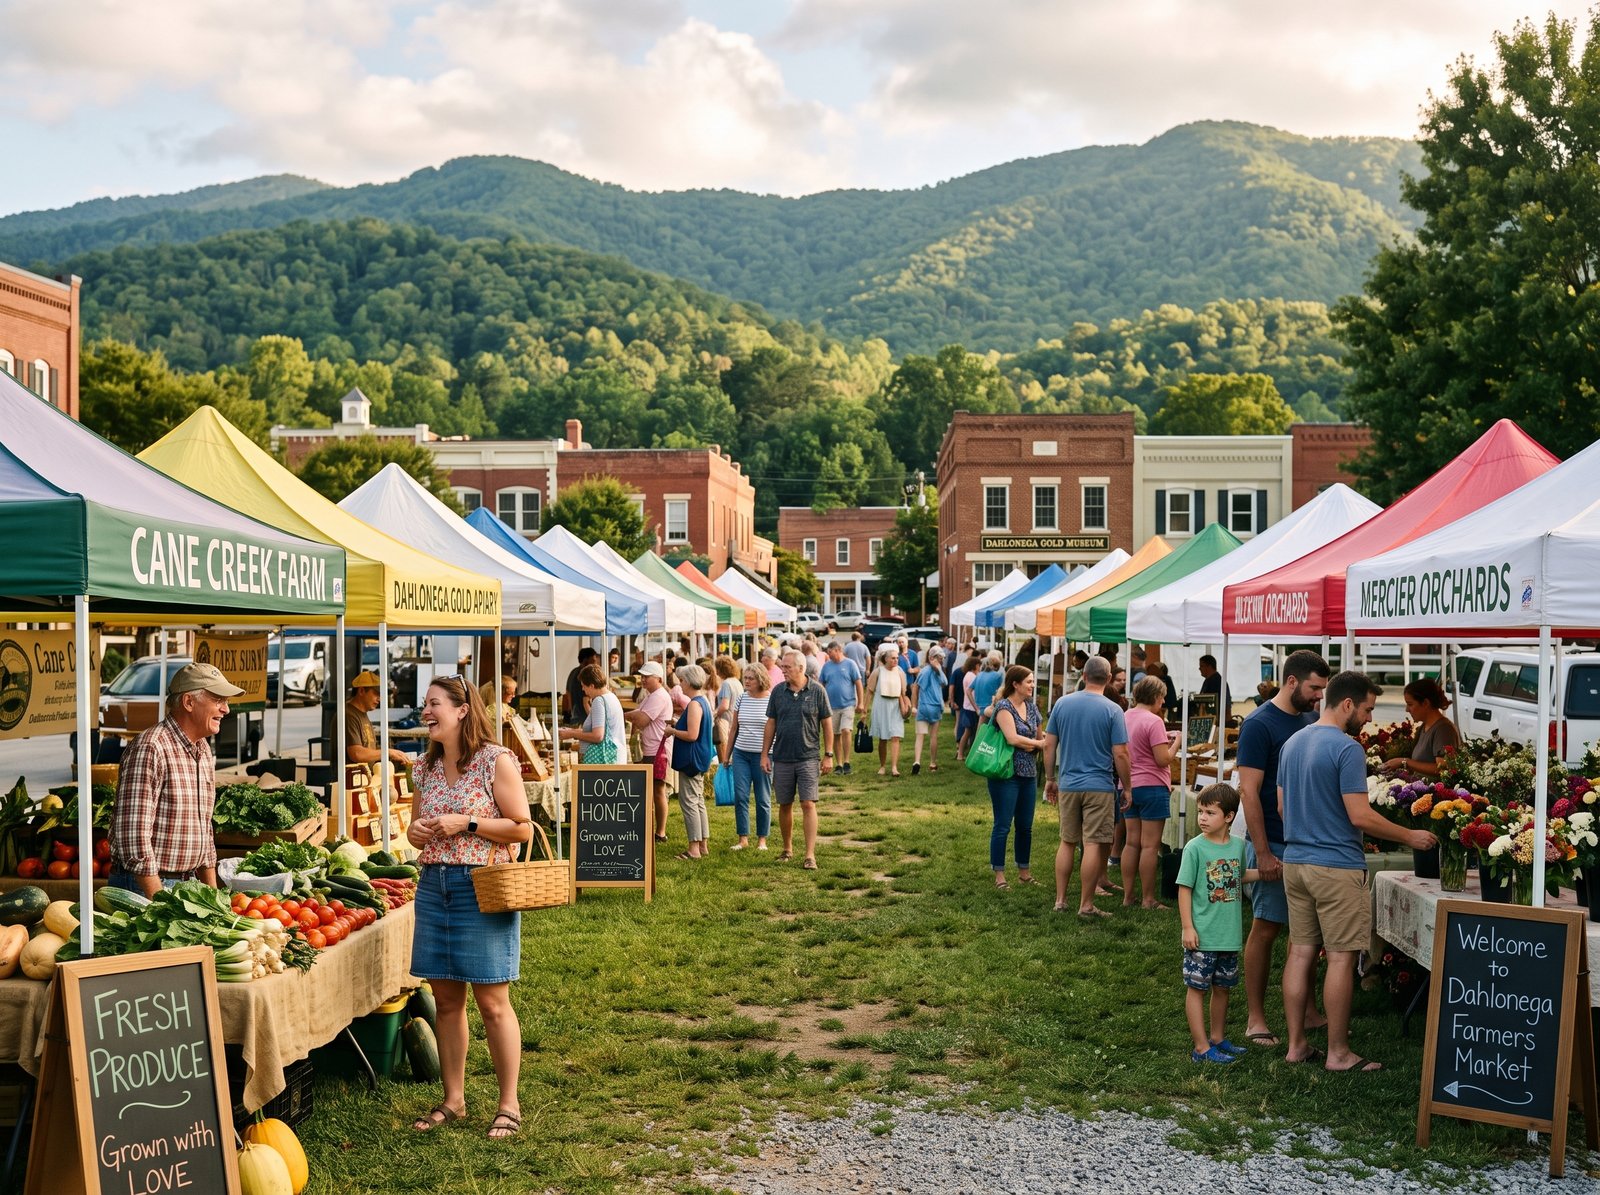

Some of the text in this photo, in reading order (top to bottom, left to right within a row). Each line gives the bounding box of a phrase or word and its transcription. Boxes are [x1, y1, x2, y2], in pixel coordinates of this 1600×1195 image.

[985, 538, 1104, 548] DAHLONEGA GOLD MUSEUM
[131, 527, 201, 589] CANE
[207, 538, 275, 596] CREEK
[278, 550, 326, 601] FARM
[394, 580, 498, 616] DAHLONEGA GOLD APIARY
[1265, 591, 1309, 624] ORCHARDS
[1360, 575, 1416, 618] MERCIER
[1419, 562, 1511, 616] ORCHARDS
[34, 642, 66, 674] Cane
[582, 778, 640, 798] LOCAL
[581, 802, 641, 823] HONEY
[579, 829, 639, 843] Grown with
[593, 844, 626, 856] LOVE
[1457, 923, 1548, 960] Welcome
[1488, 960, 1509, 977] to
[94, 989, 192, 1040] FRESH
[1448, 977, 1554, 1026] Dahlonega
[1452, 1013, 1536, 1051] Farmers
[90, 1040, 209, 1098] PRODUCE
[1454, 1046, 1533, 1082] Market
[100, 1119, 216, 1172] Grown with
[128, 1160, 193, 1195] LOVE
